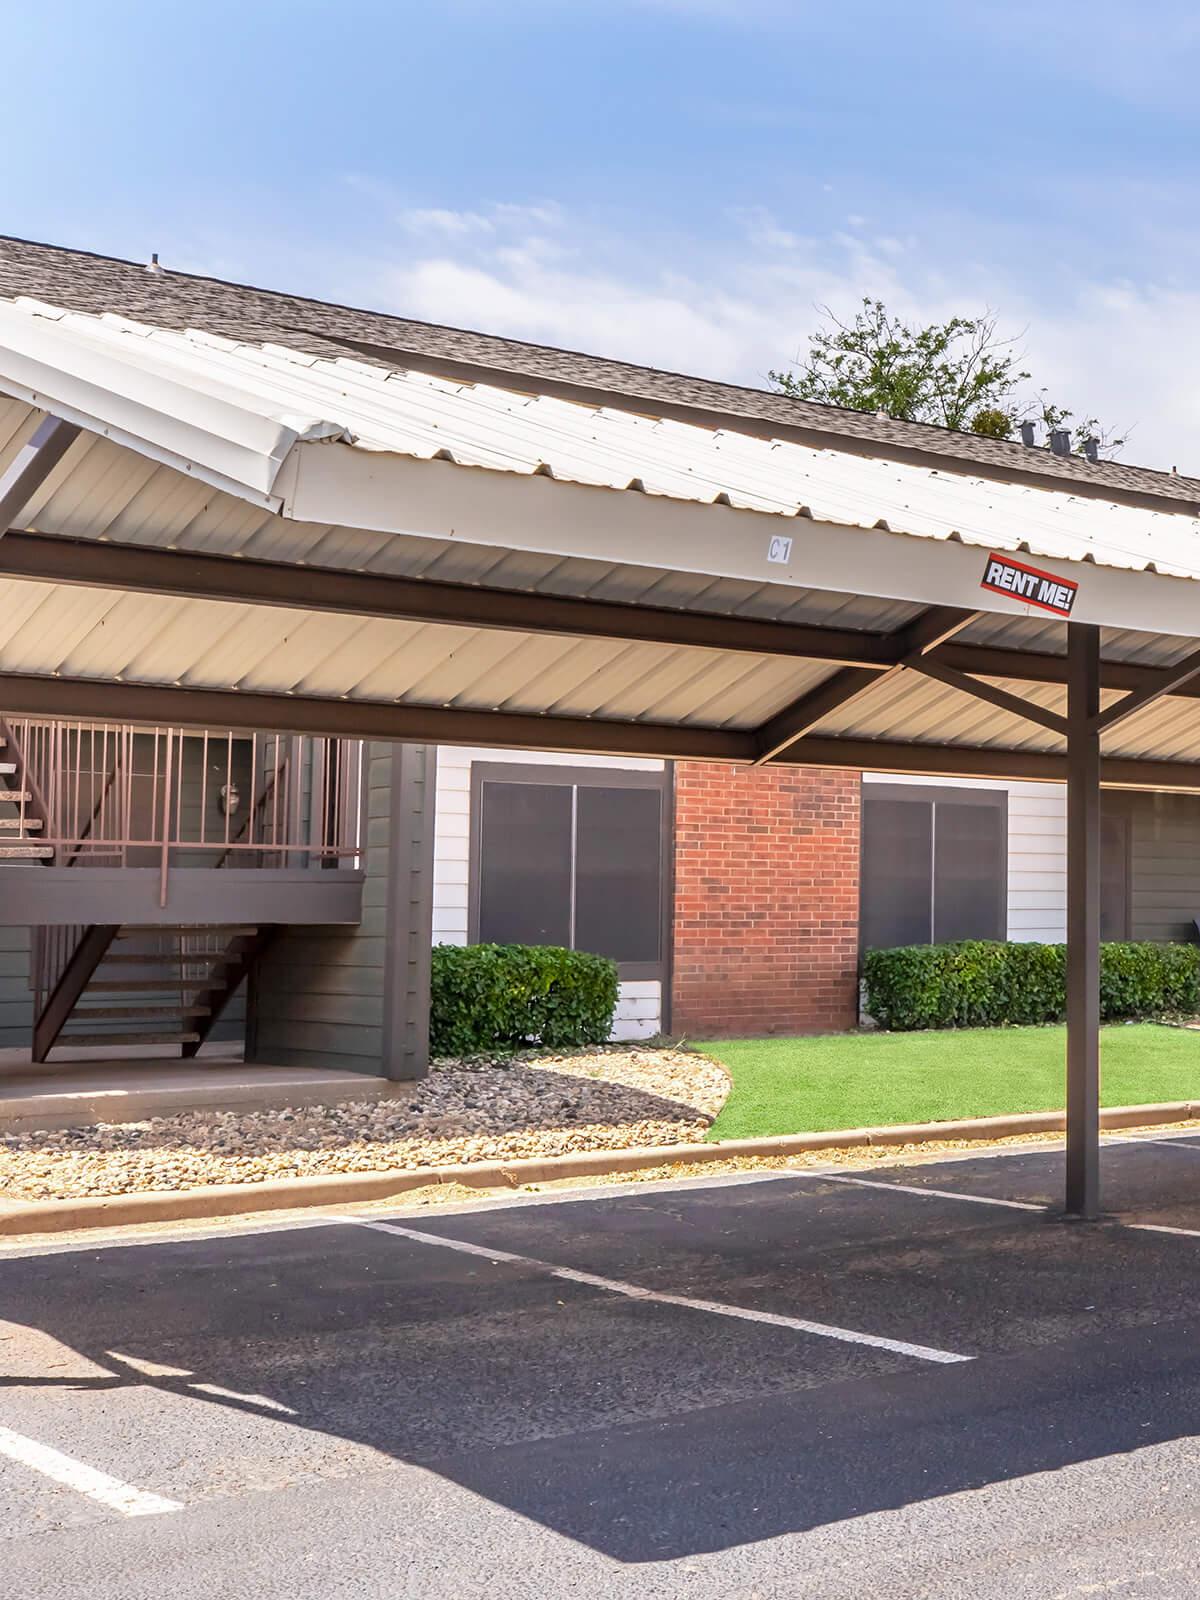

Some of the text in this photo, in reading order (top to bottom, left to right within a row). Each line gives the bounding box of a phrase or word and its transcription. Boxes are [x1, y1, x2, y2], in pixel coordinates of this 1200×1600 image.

[770, 539, 790, 560] C1
[985, 561, 1074, 610] RENT ME!
